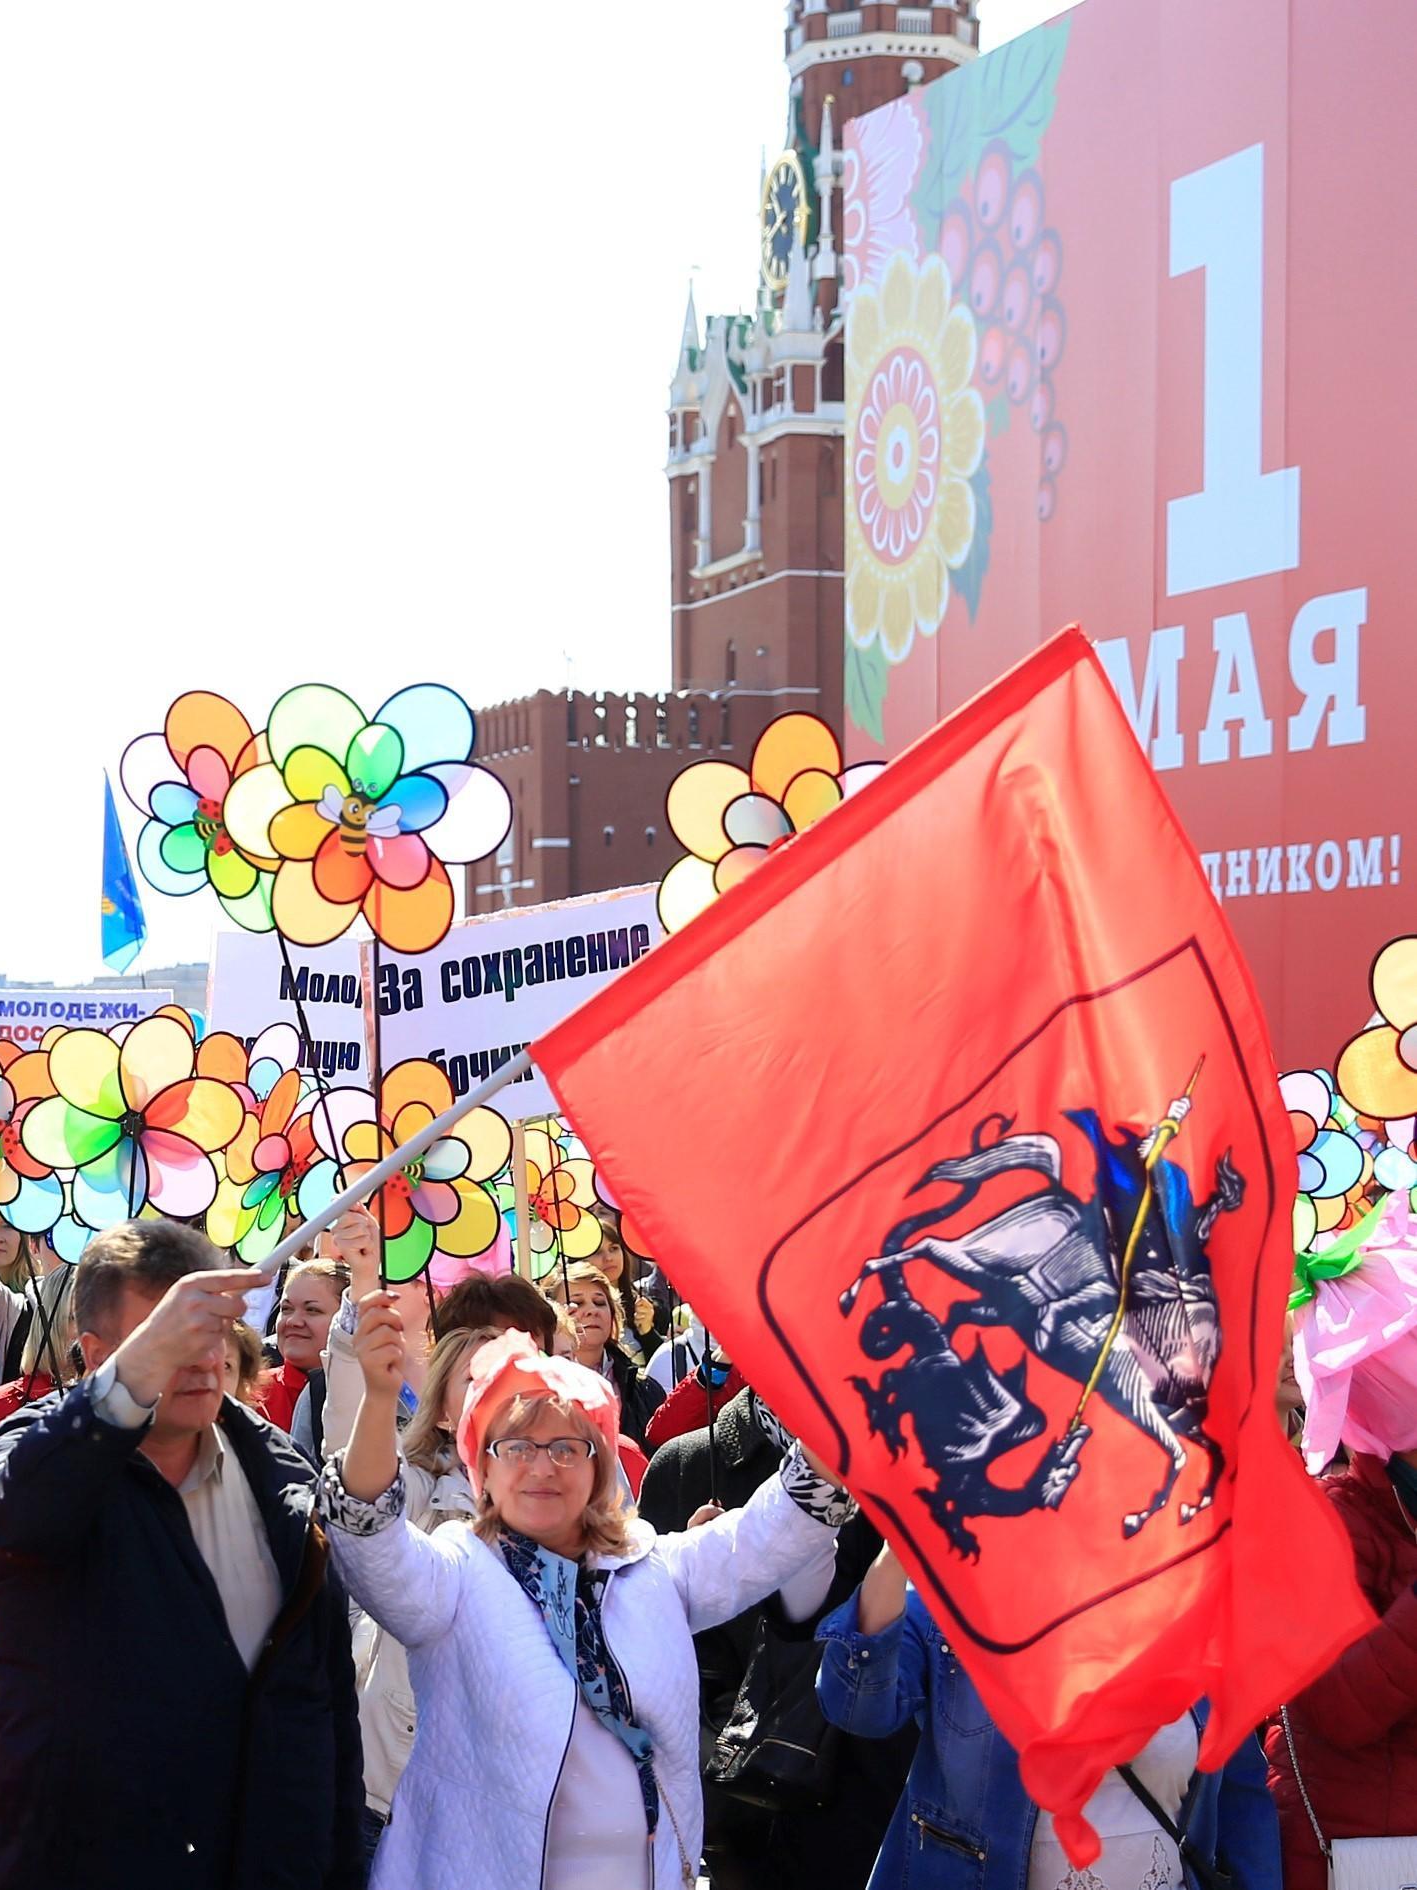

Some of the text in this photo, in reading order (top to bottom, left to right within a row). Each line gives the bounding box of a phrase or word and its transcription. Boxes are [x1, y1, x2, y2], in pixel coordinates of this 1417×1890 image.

[1166, 141, 1300, 597] 1
[1094, 587, 1368, 772] МАЯ
[1199, 834, 1401, 908] ДНИКОМ!
[279, 965, 363, 1009] Моло
[378, 923, 650, 1017] За сохранение
